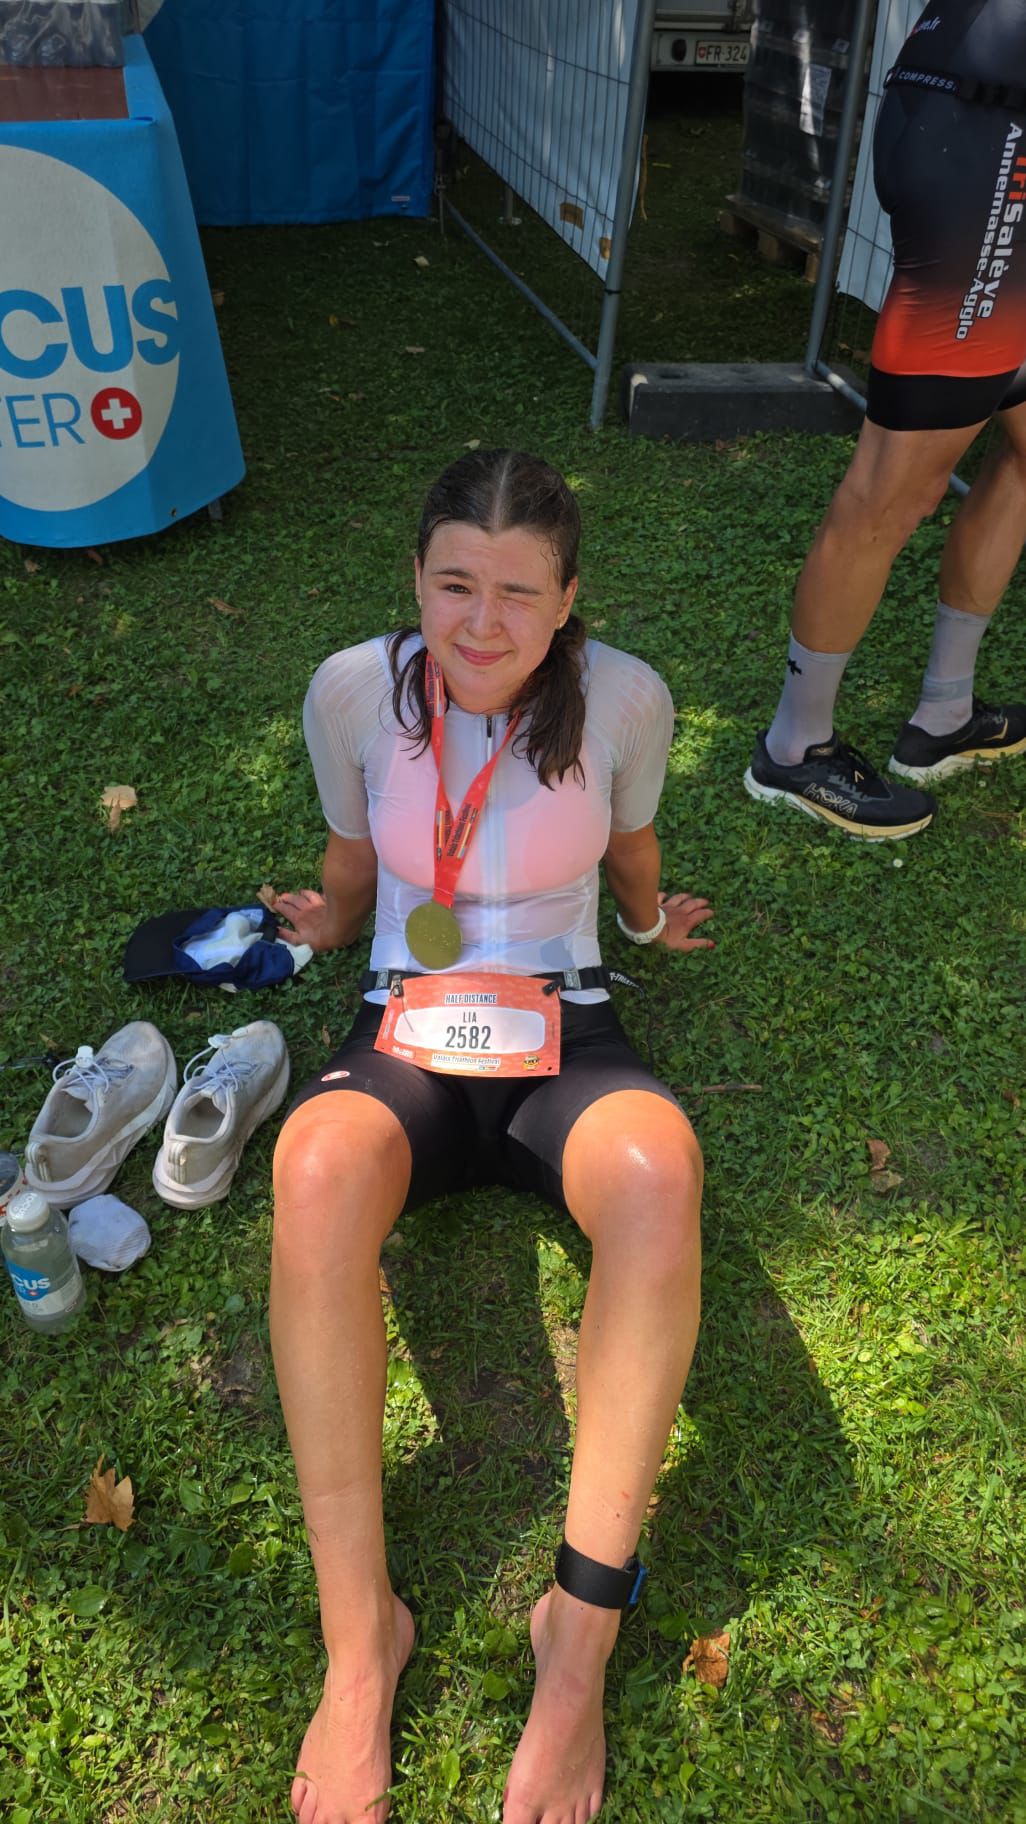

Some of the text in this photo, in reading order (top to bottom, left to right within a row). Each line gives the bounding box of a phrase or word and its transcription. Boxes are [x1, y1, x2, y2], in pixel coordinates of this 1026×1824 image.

[0, 392, 86, 449] ER
[462, 1011, 477, 1024] LIA
[445, 1025, 492, 1050] 2582
